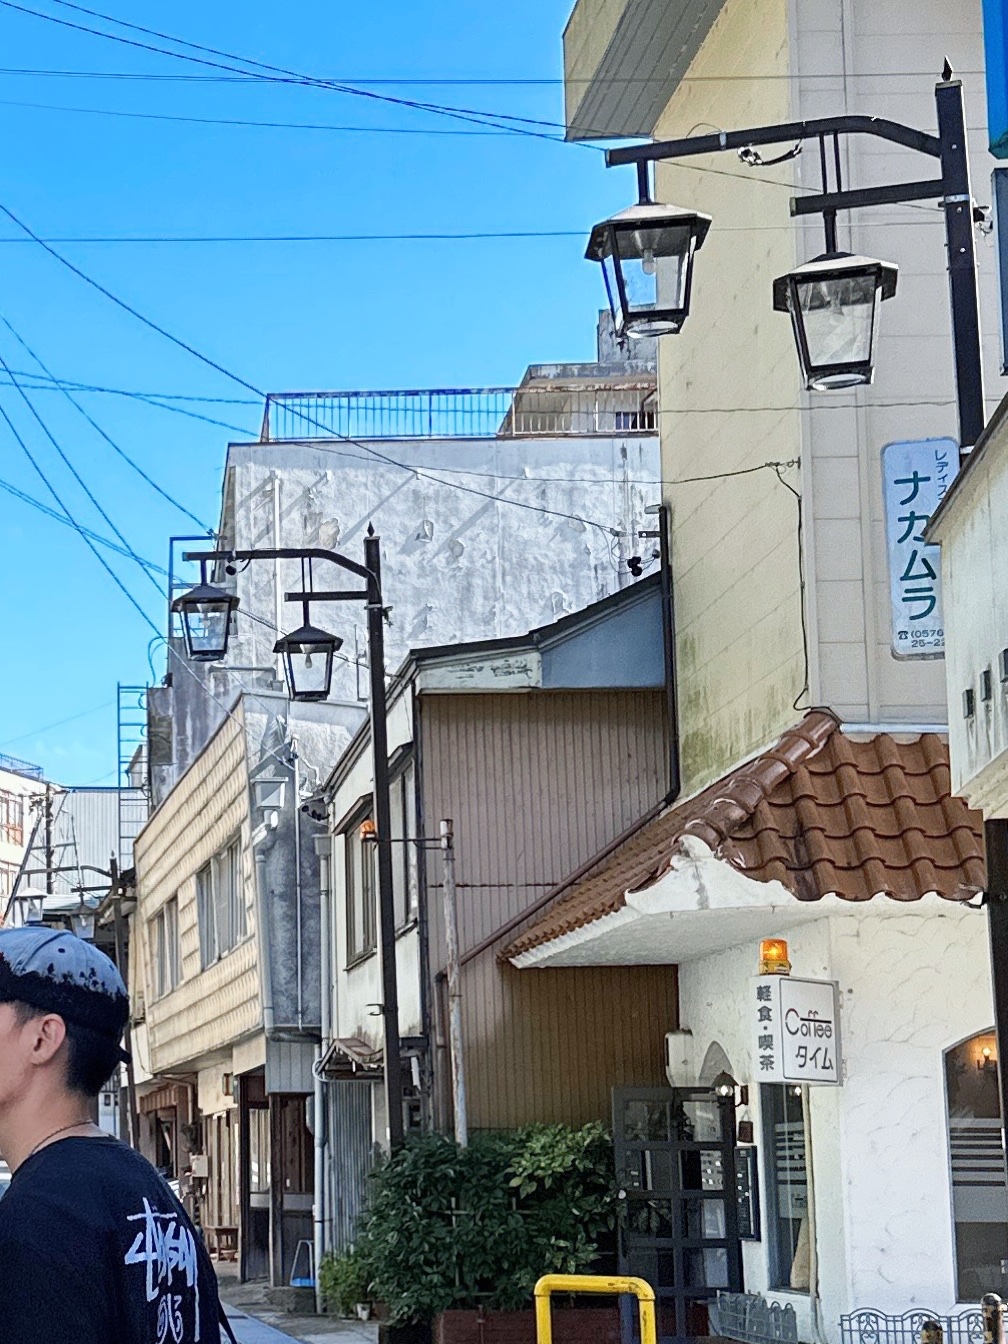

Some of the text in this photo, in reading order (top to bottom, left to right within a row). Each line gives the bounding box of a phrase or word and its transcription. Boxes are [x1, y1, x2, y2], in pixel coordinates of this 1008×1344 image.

[894, 470, 936, 620] ナカムラ
[756, 985, 775, 1071] 軽食・喫茶
[785, 1008, 832, 1039] Coffee
[795, 1046, 834, 1070] タイム
